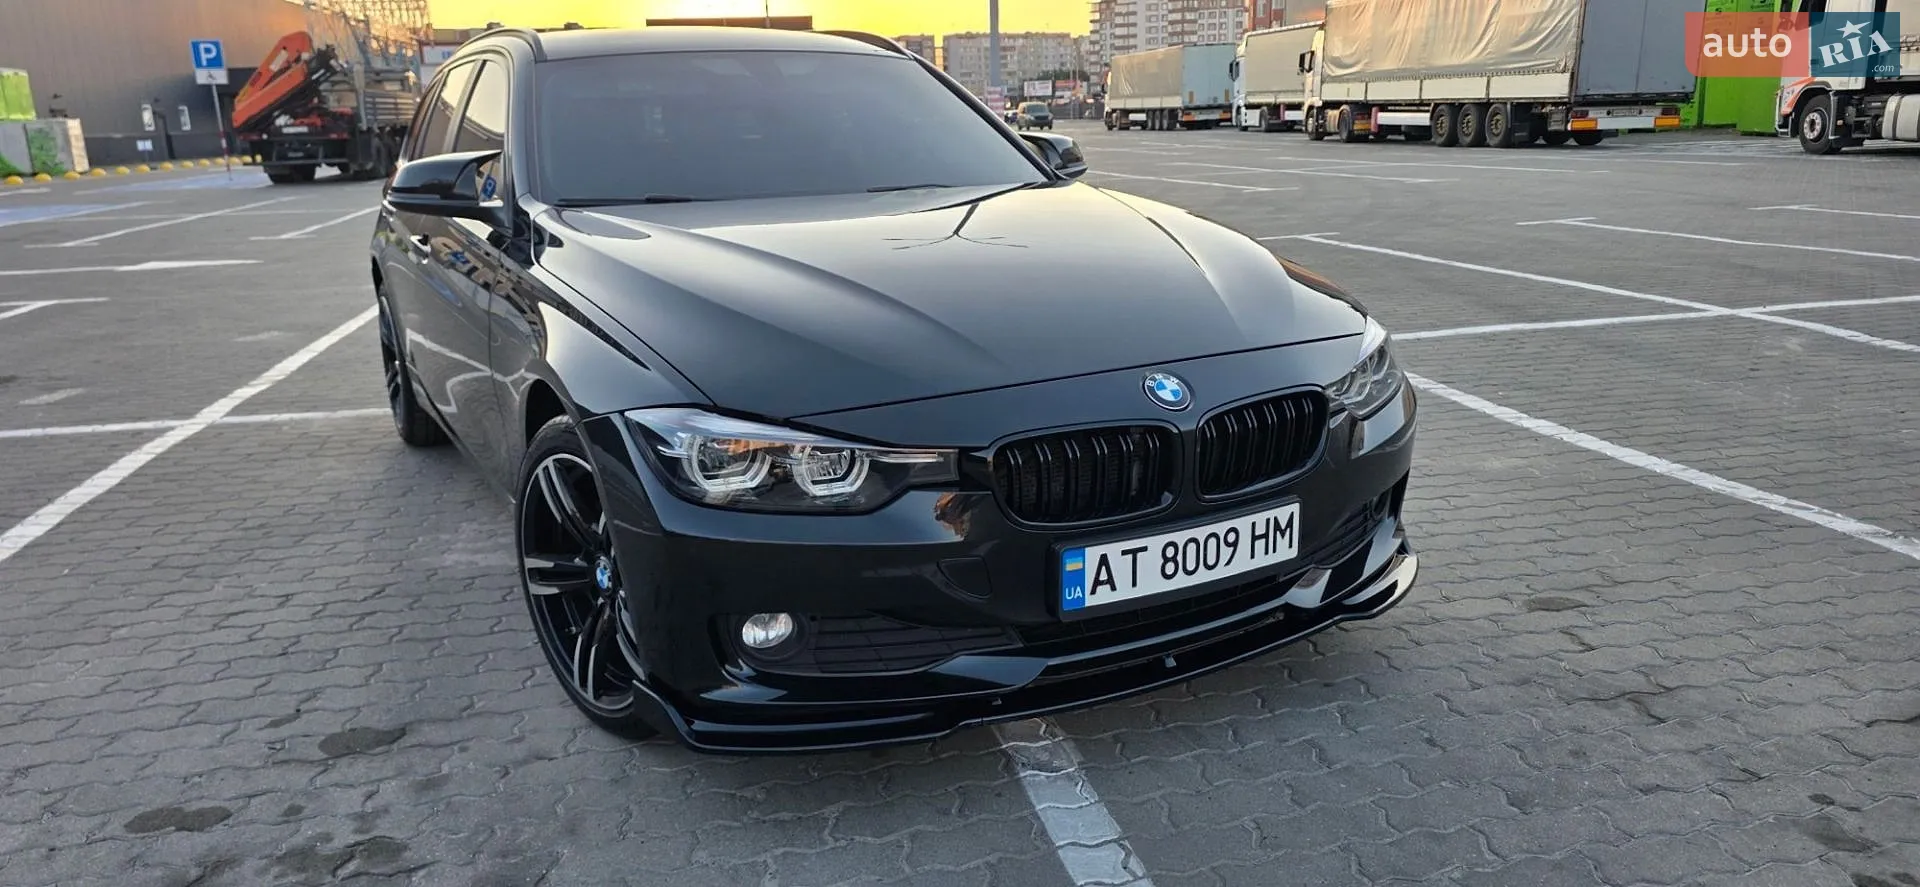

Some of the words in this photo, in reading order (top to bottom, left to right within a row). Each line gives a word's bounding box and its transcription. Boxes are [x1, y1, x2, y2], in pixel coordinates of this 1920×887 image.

[199, 43, 217, 66] P
[1089, 546, 1149, 596] AT
[1160, 526, 1240, 580] 8009
[1250, 511, 1295, 559] HM
[1065, 586, 1083, 600] UA
